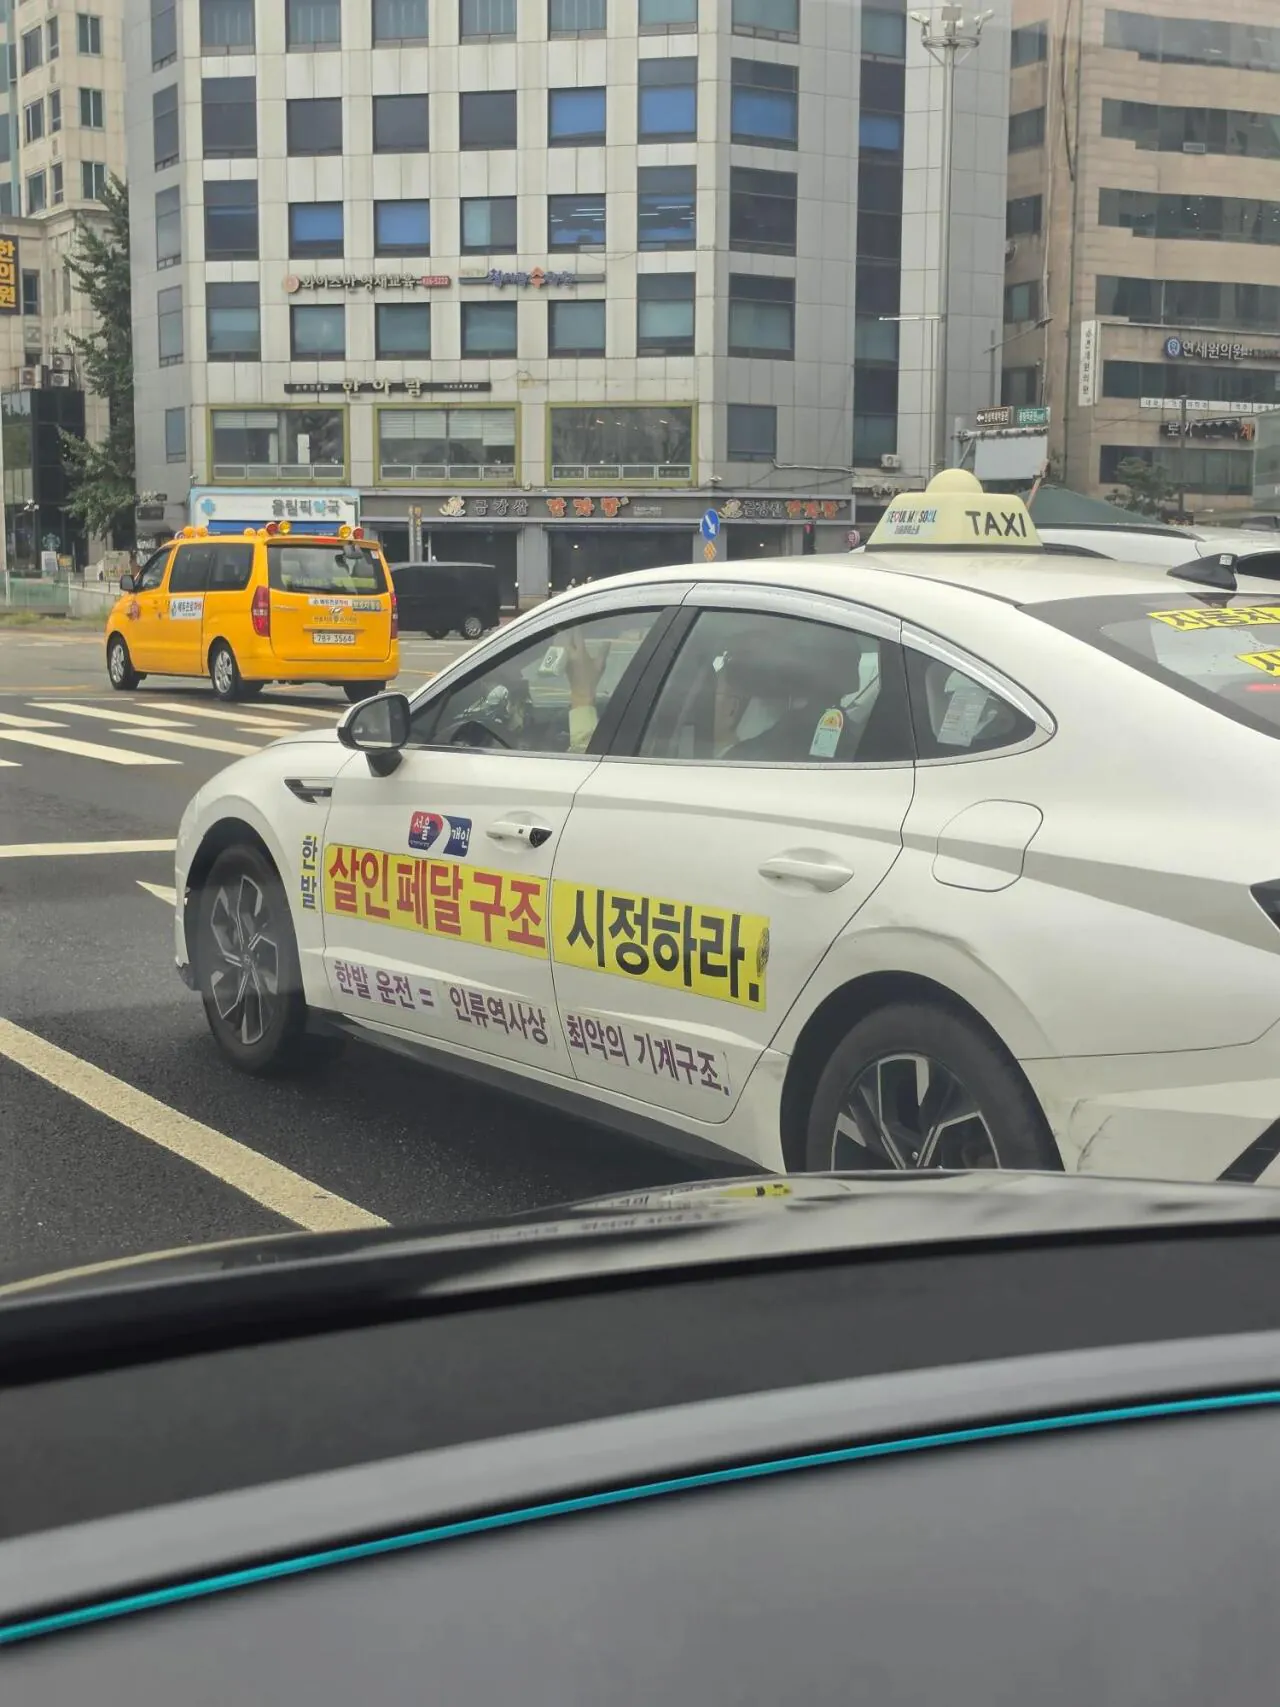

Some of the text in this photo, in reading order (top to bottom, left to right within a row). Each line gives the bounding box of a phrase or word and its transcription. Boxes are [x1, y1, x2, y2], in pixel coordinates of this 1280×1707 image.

[1182, 340, 1244, 360] 연세원의원
[272, 499, 340, 517] 올림픽약국
[473, 498, 529, 516] 금강산
[965, 510, 1027, 537] TAXI
[414, 815, 431, 841] 서울
[450, 826, 471, 849] 개인
[301, 835, 318, 909] 한발
[328, 847, 390, 920] 살인
[566, 889, 760, 1003] 시정하라.
[334, 960, 731, 1097] 한발 운전 = 인류역사상 최악의 기계구조.
